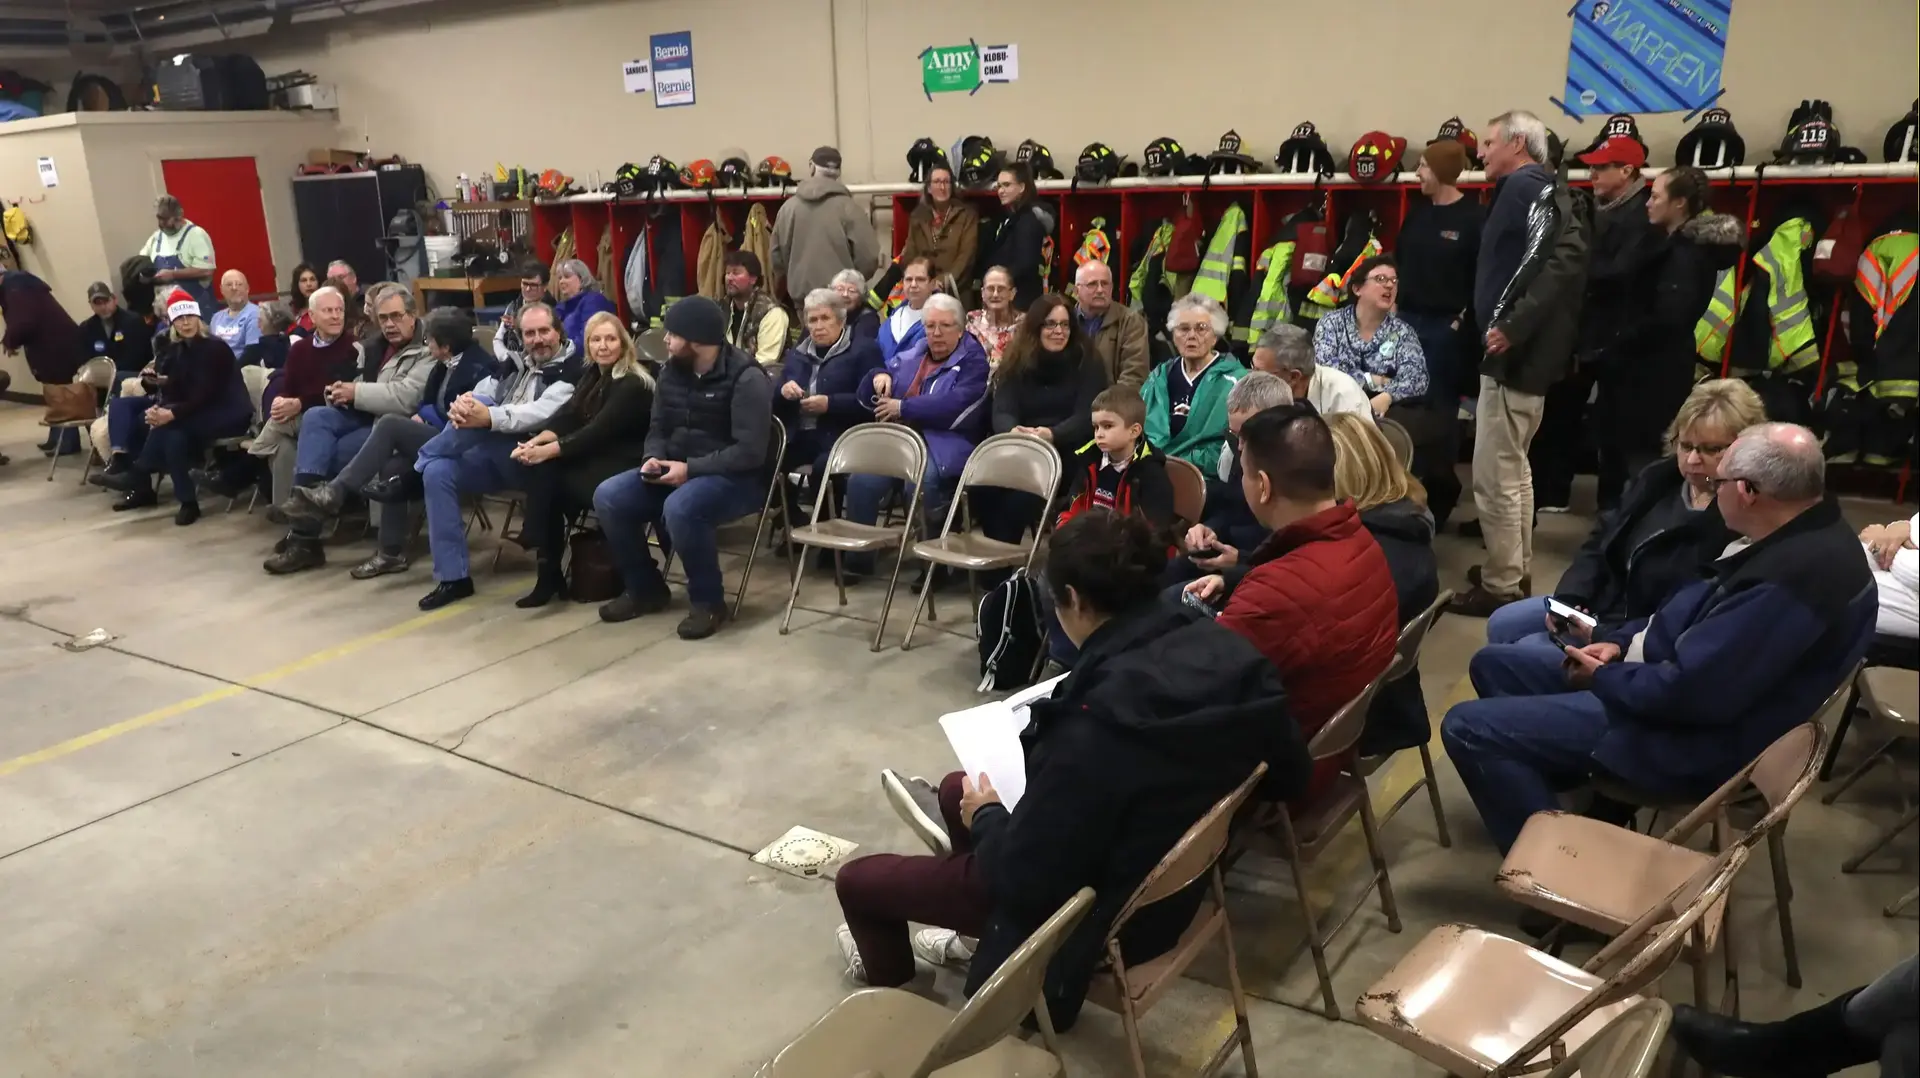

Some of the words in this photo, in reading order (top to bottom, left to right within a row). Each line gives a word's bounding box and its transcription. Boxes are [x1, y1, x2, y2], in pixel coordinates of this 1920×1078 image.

[654, 43, 689, 59] Bernie
[1603, 0, 1720, 96] WARREN
[927, 50, 975, 71] Amy
[983, 51, 1009, 62] KLOBU-
[625, 65, 648, 75] SANDERS
[984, 65, 1004, 76] CHAR
[657, 79, 691, 94] Bernie
[1292, 127, 1311, 136] 117
[1608, 122, 1632, 135] 121
[1800, 129, 1827, 143] 119
[1219, 141, 1238, 150] 107
[1148, 153, 1161, 164] 97
